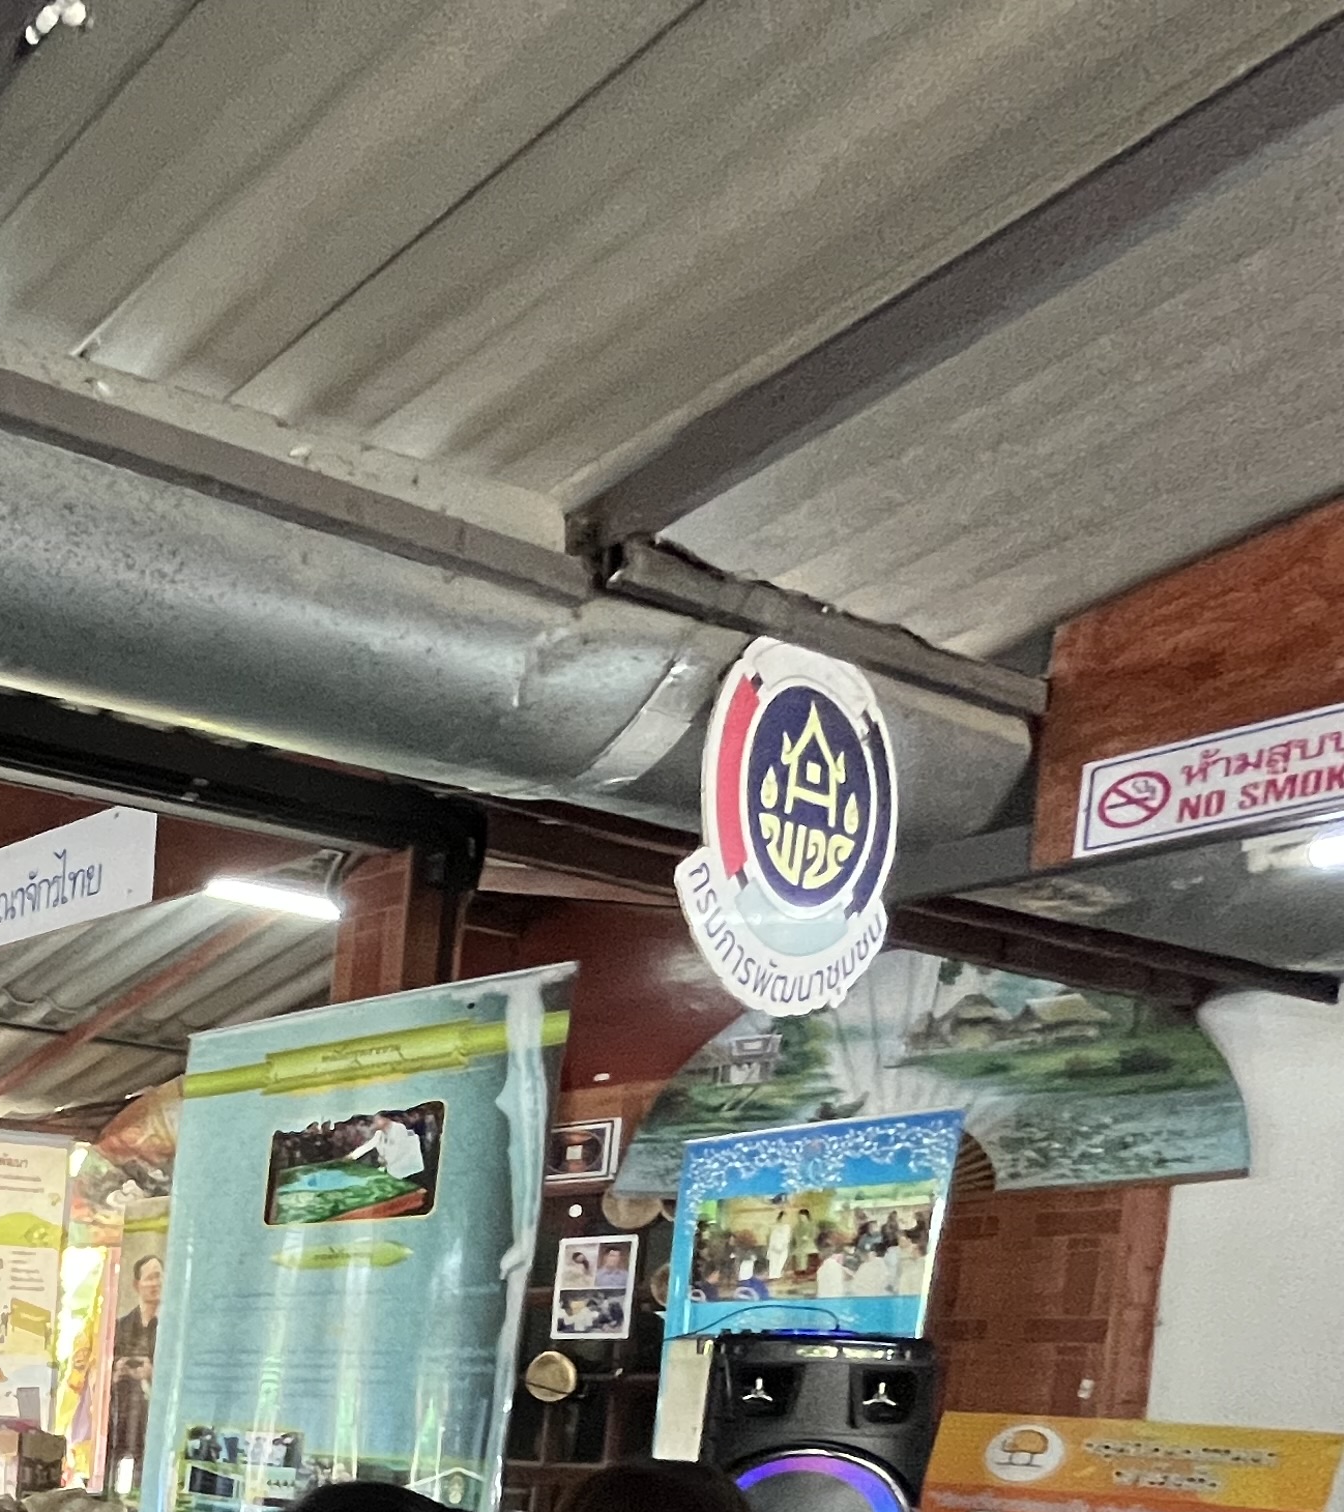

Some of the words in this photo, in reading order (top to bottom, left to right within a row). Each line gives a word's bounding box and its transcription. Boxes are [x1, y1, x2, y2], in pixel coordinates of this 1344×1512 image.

[1176, 789, 1226, 823] NO
[1238, 766, 1344, 810] SMOK
[688, 862, 883, 1003] กรมการพัฒนาชุมชน
